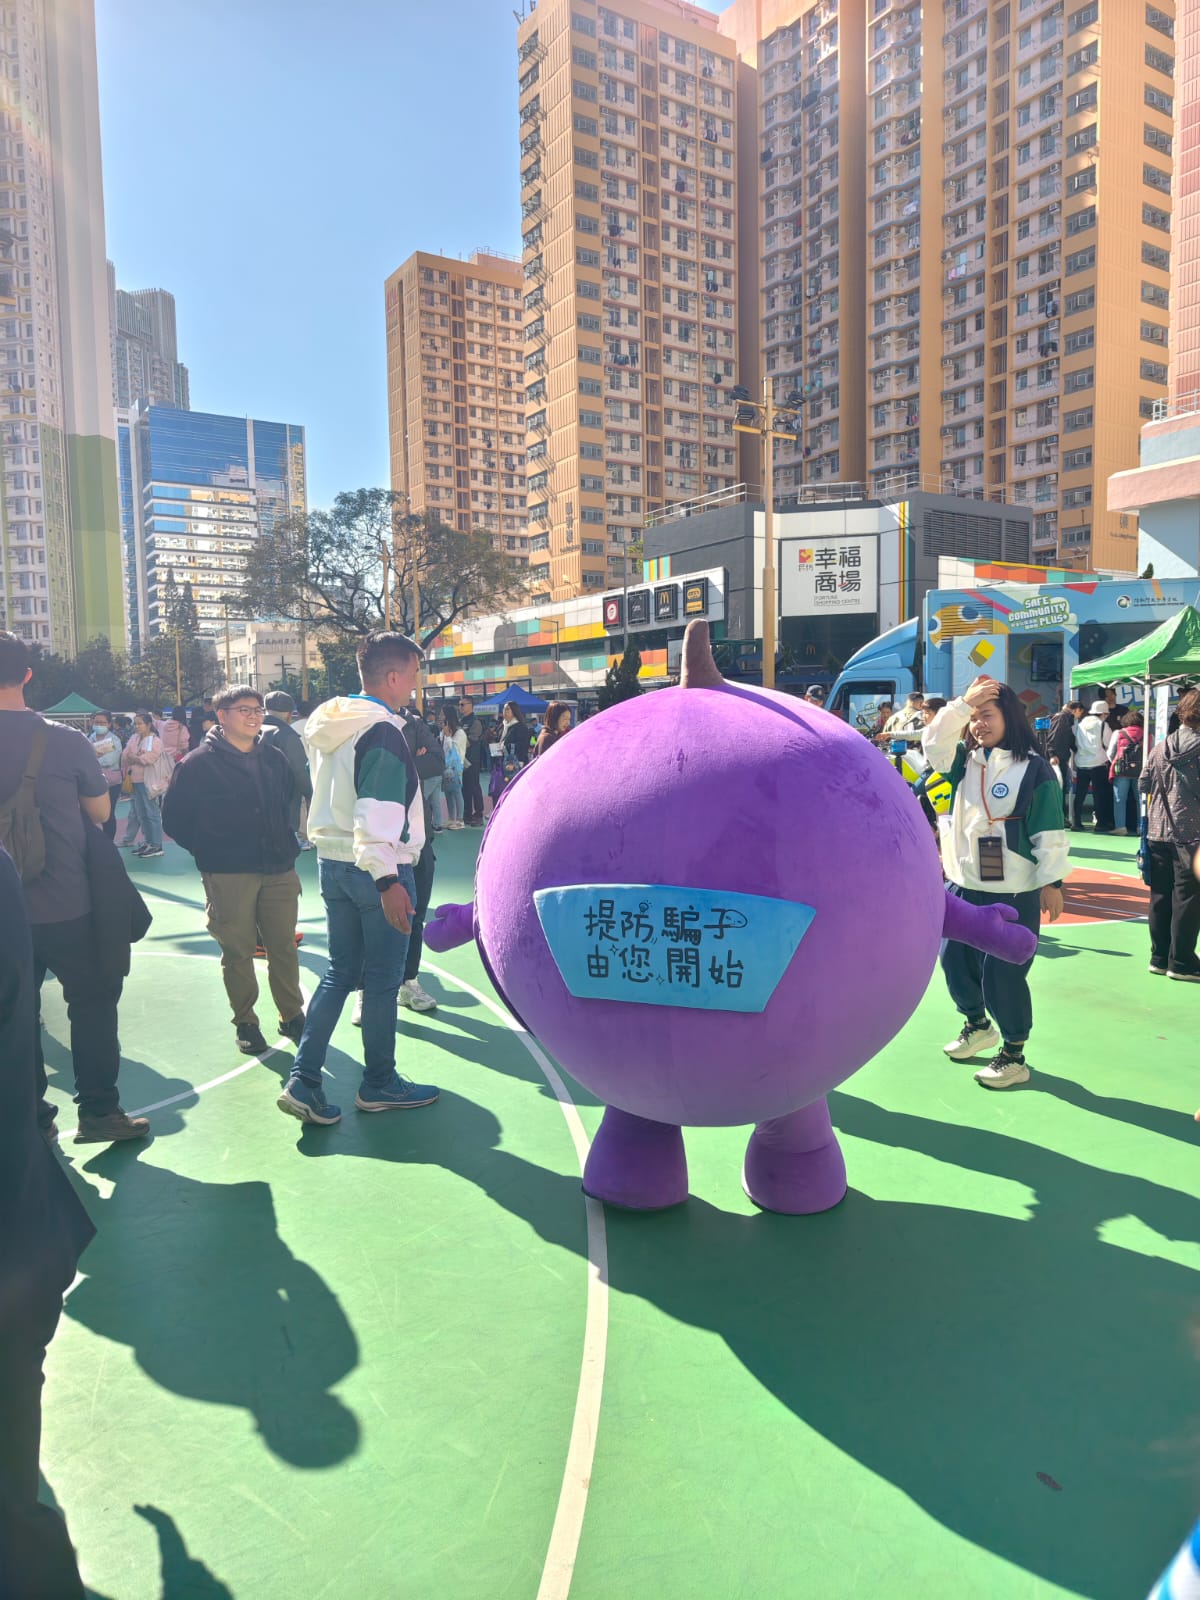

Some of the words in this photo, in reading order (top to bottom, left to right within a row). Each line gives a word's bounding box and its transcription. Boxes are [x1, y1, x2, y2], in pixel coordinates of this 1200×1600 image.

[815, 546, 861, 569] 幸福
[815, 570, 861, 593] 商場
[1008, 603, 1067, 622] COMMUNITY
[1025, 596, 1049, 609] SAFE
[583, 899, 743, 946] 提防騙子
[587, 944, 745, 988] 由您開始
